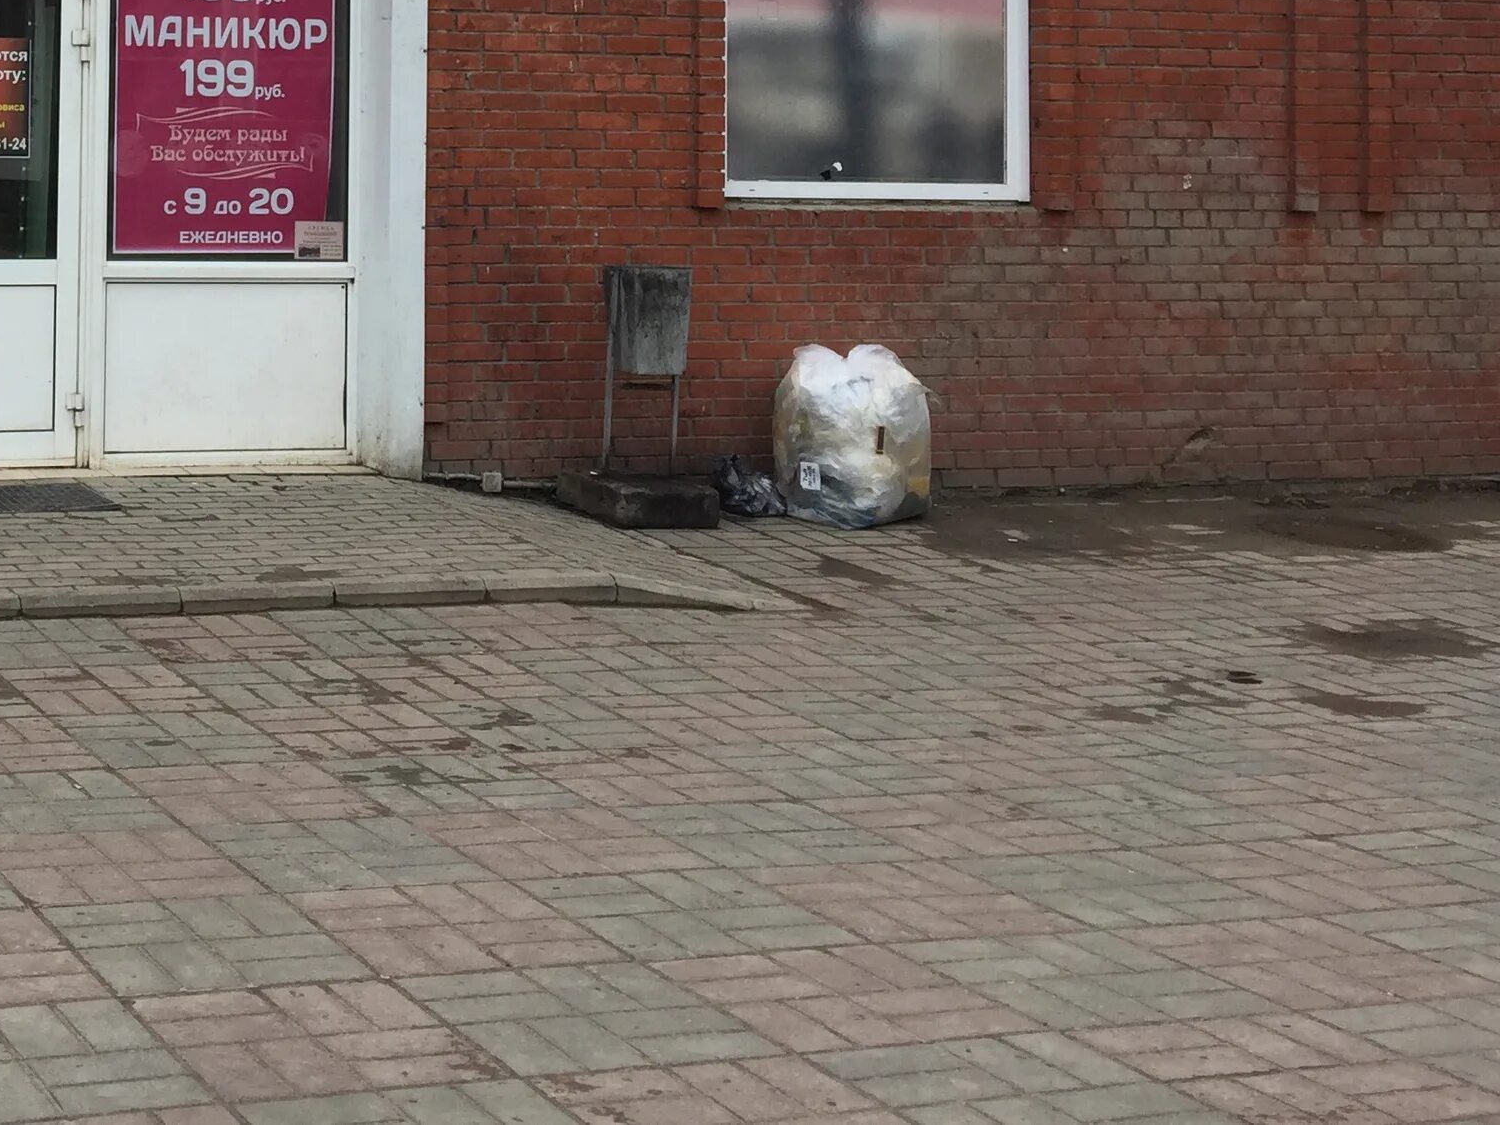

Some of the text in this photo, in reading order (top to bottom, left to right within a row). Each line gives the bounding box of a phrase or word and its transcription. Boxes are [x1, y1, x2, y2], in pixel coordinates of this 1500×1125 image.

[124, 14, 328, 51] МАНИКЮР
[179, 58, 286, 101] 199 руб.
[168, 125, 288, 145] Будем рады
[192, 145, 305, 166] обслужить!
[163, 187, 295, 216] с 9 до 20
[179, 230, 284, 244] ЕЖЕДНЕВНО
